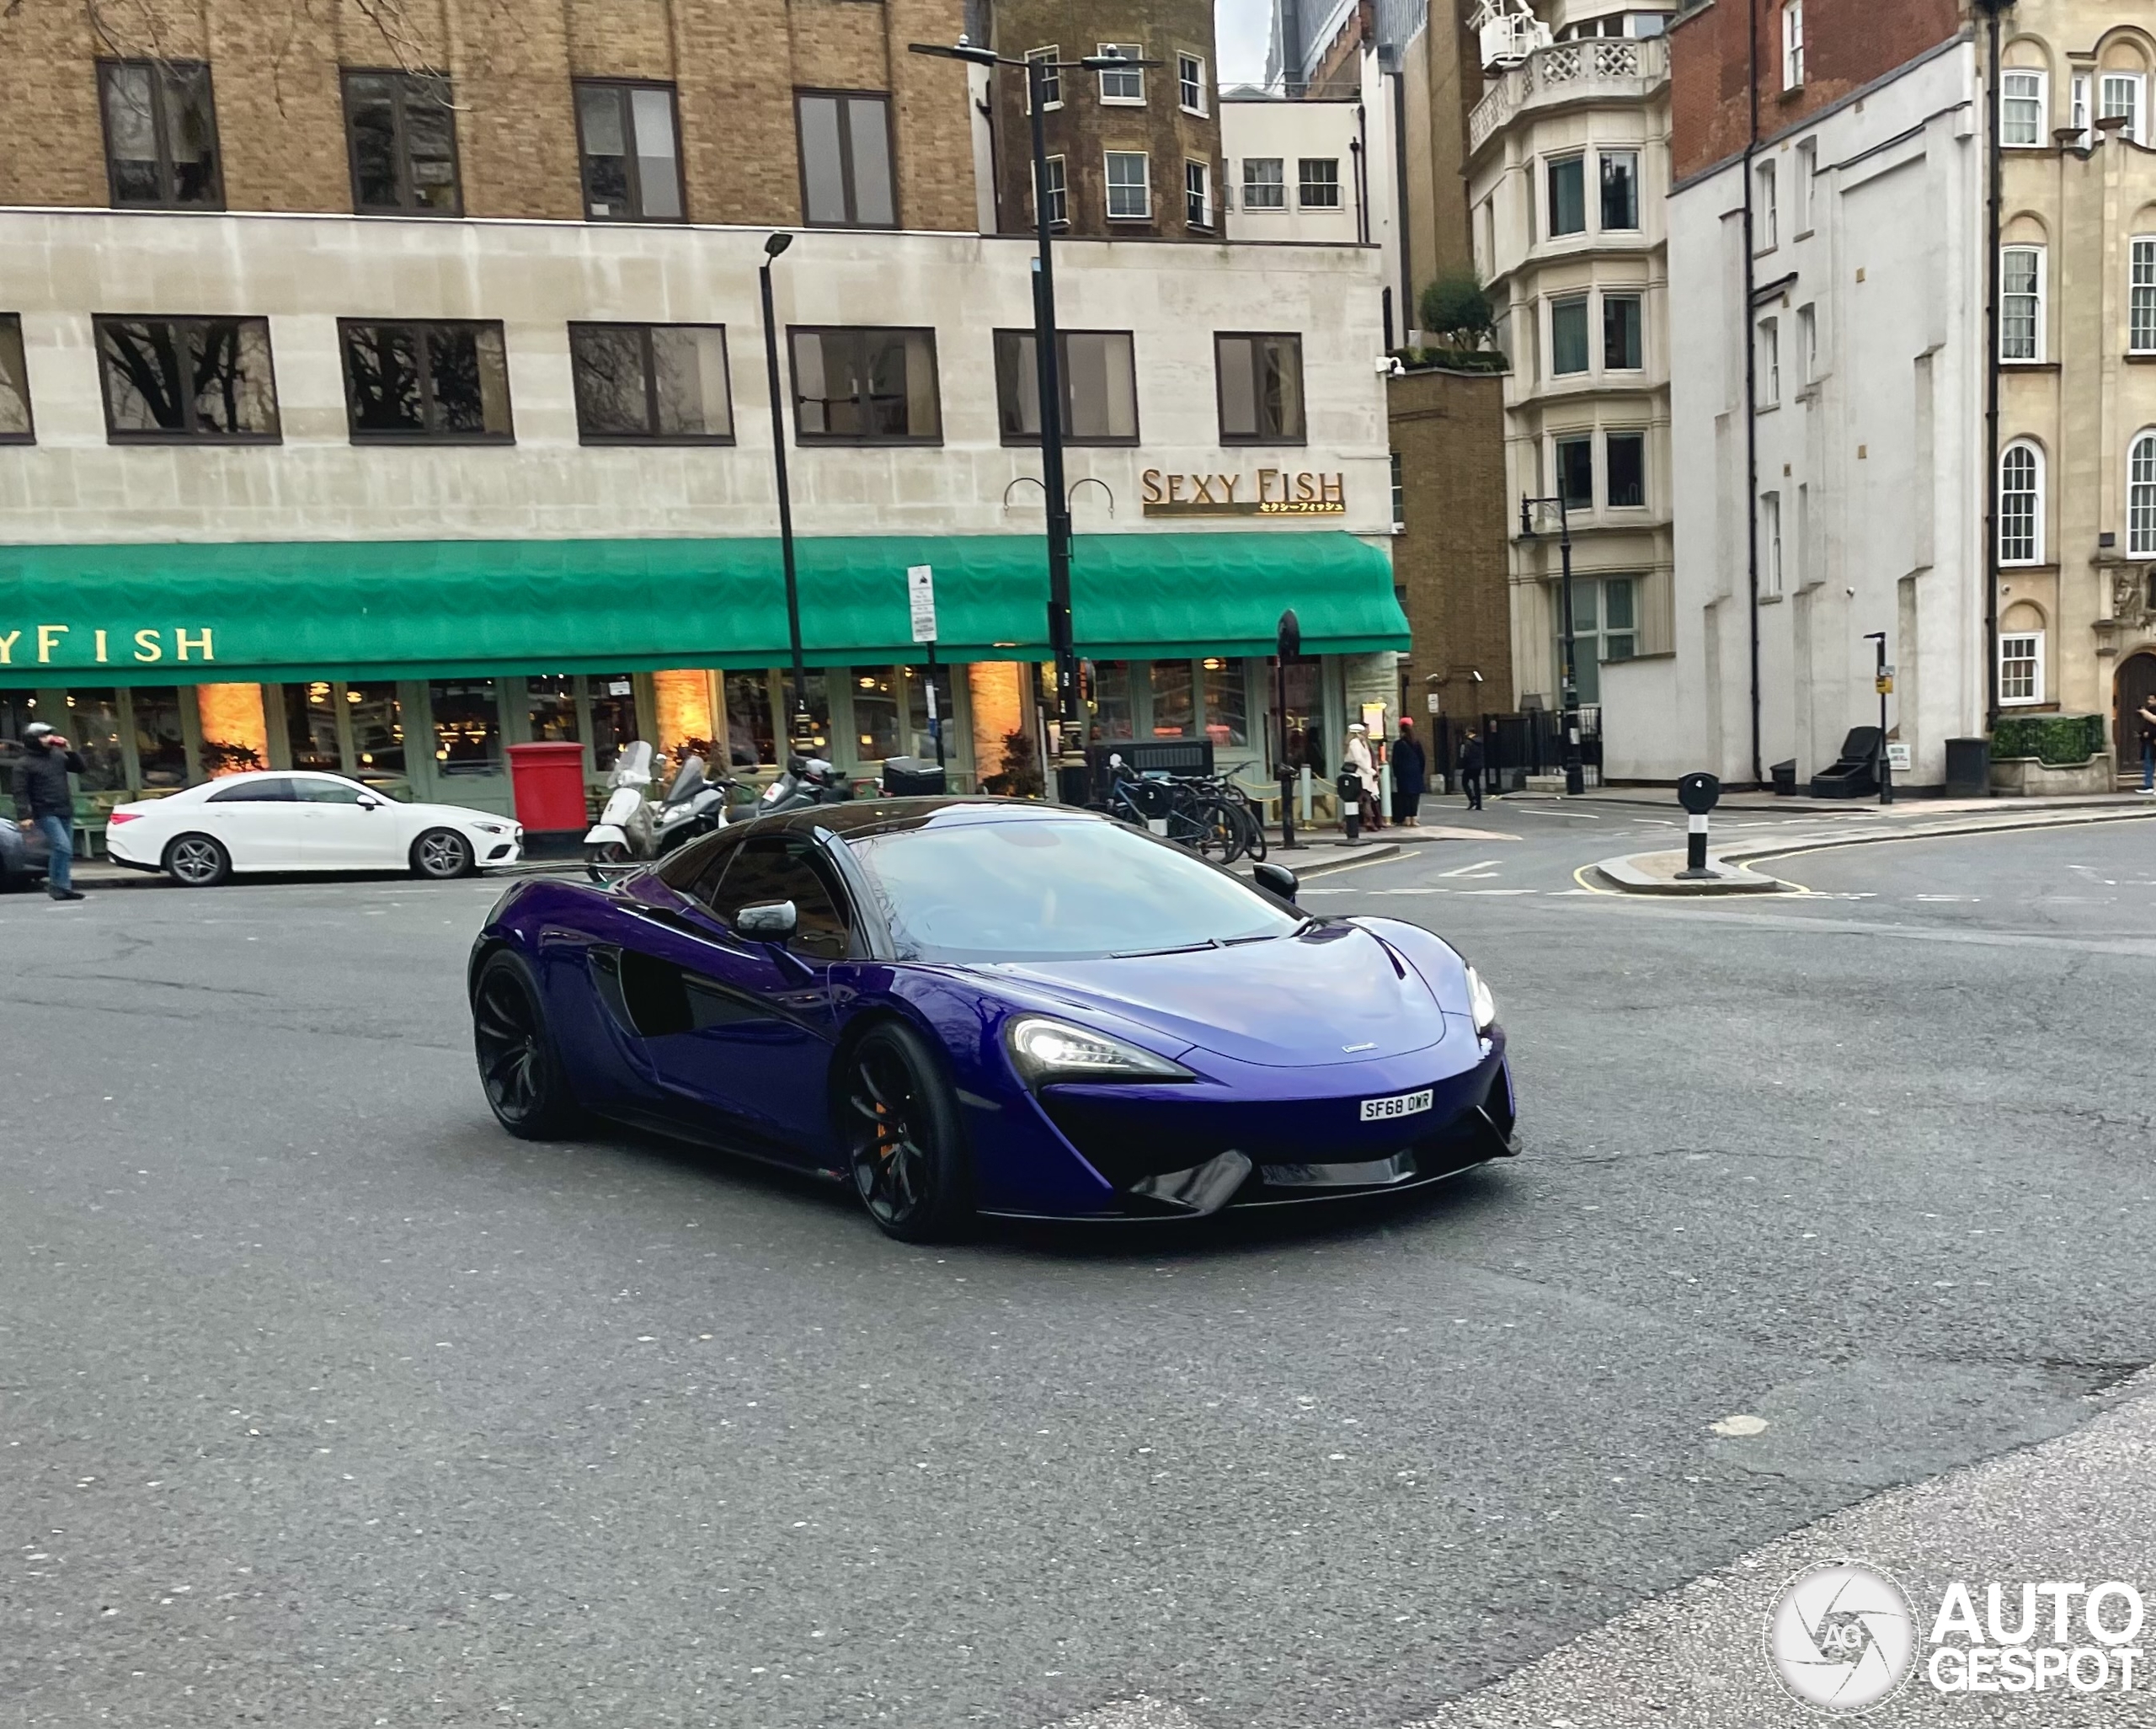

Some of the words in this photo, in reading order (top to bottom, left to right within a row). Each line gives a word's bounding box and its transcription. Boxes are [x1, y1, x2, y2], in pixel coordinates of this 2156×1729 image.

[1142, 468, 1240, 504] SEXY
[1257, 468, 1344, 504] FISH
[1260, 502, 1344, 512] セクシーフィッシュ
[1365, 1099, 1403, 1118] SF68
